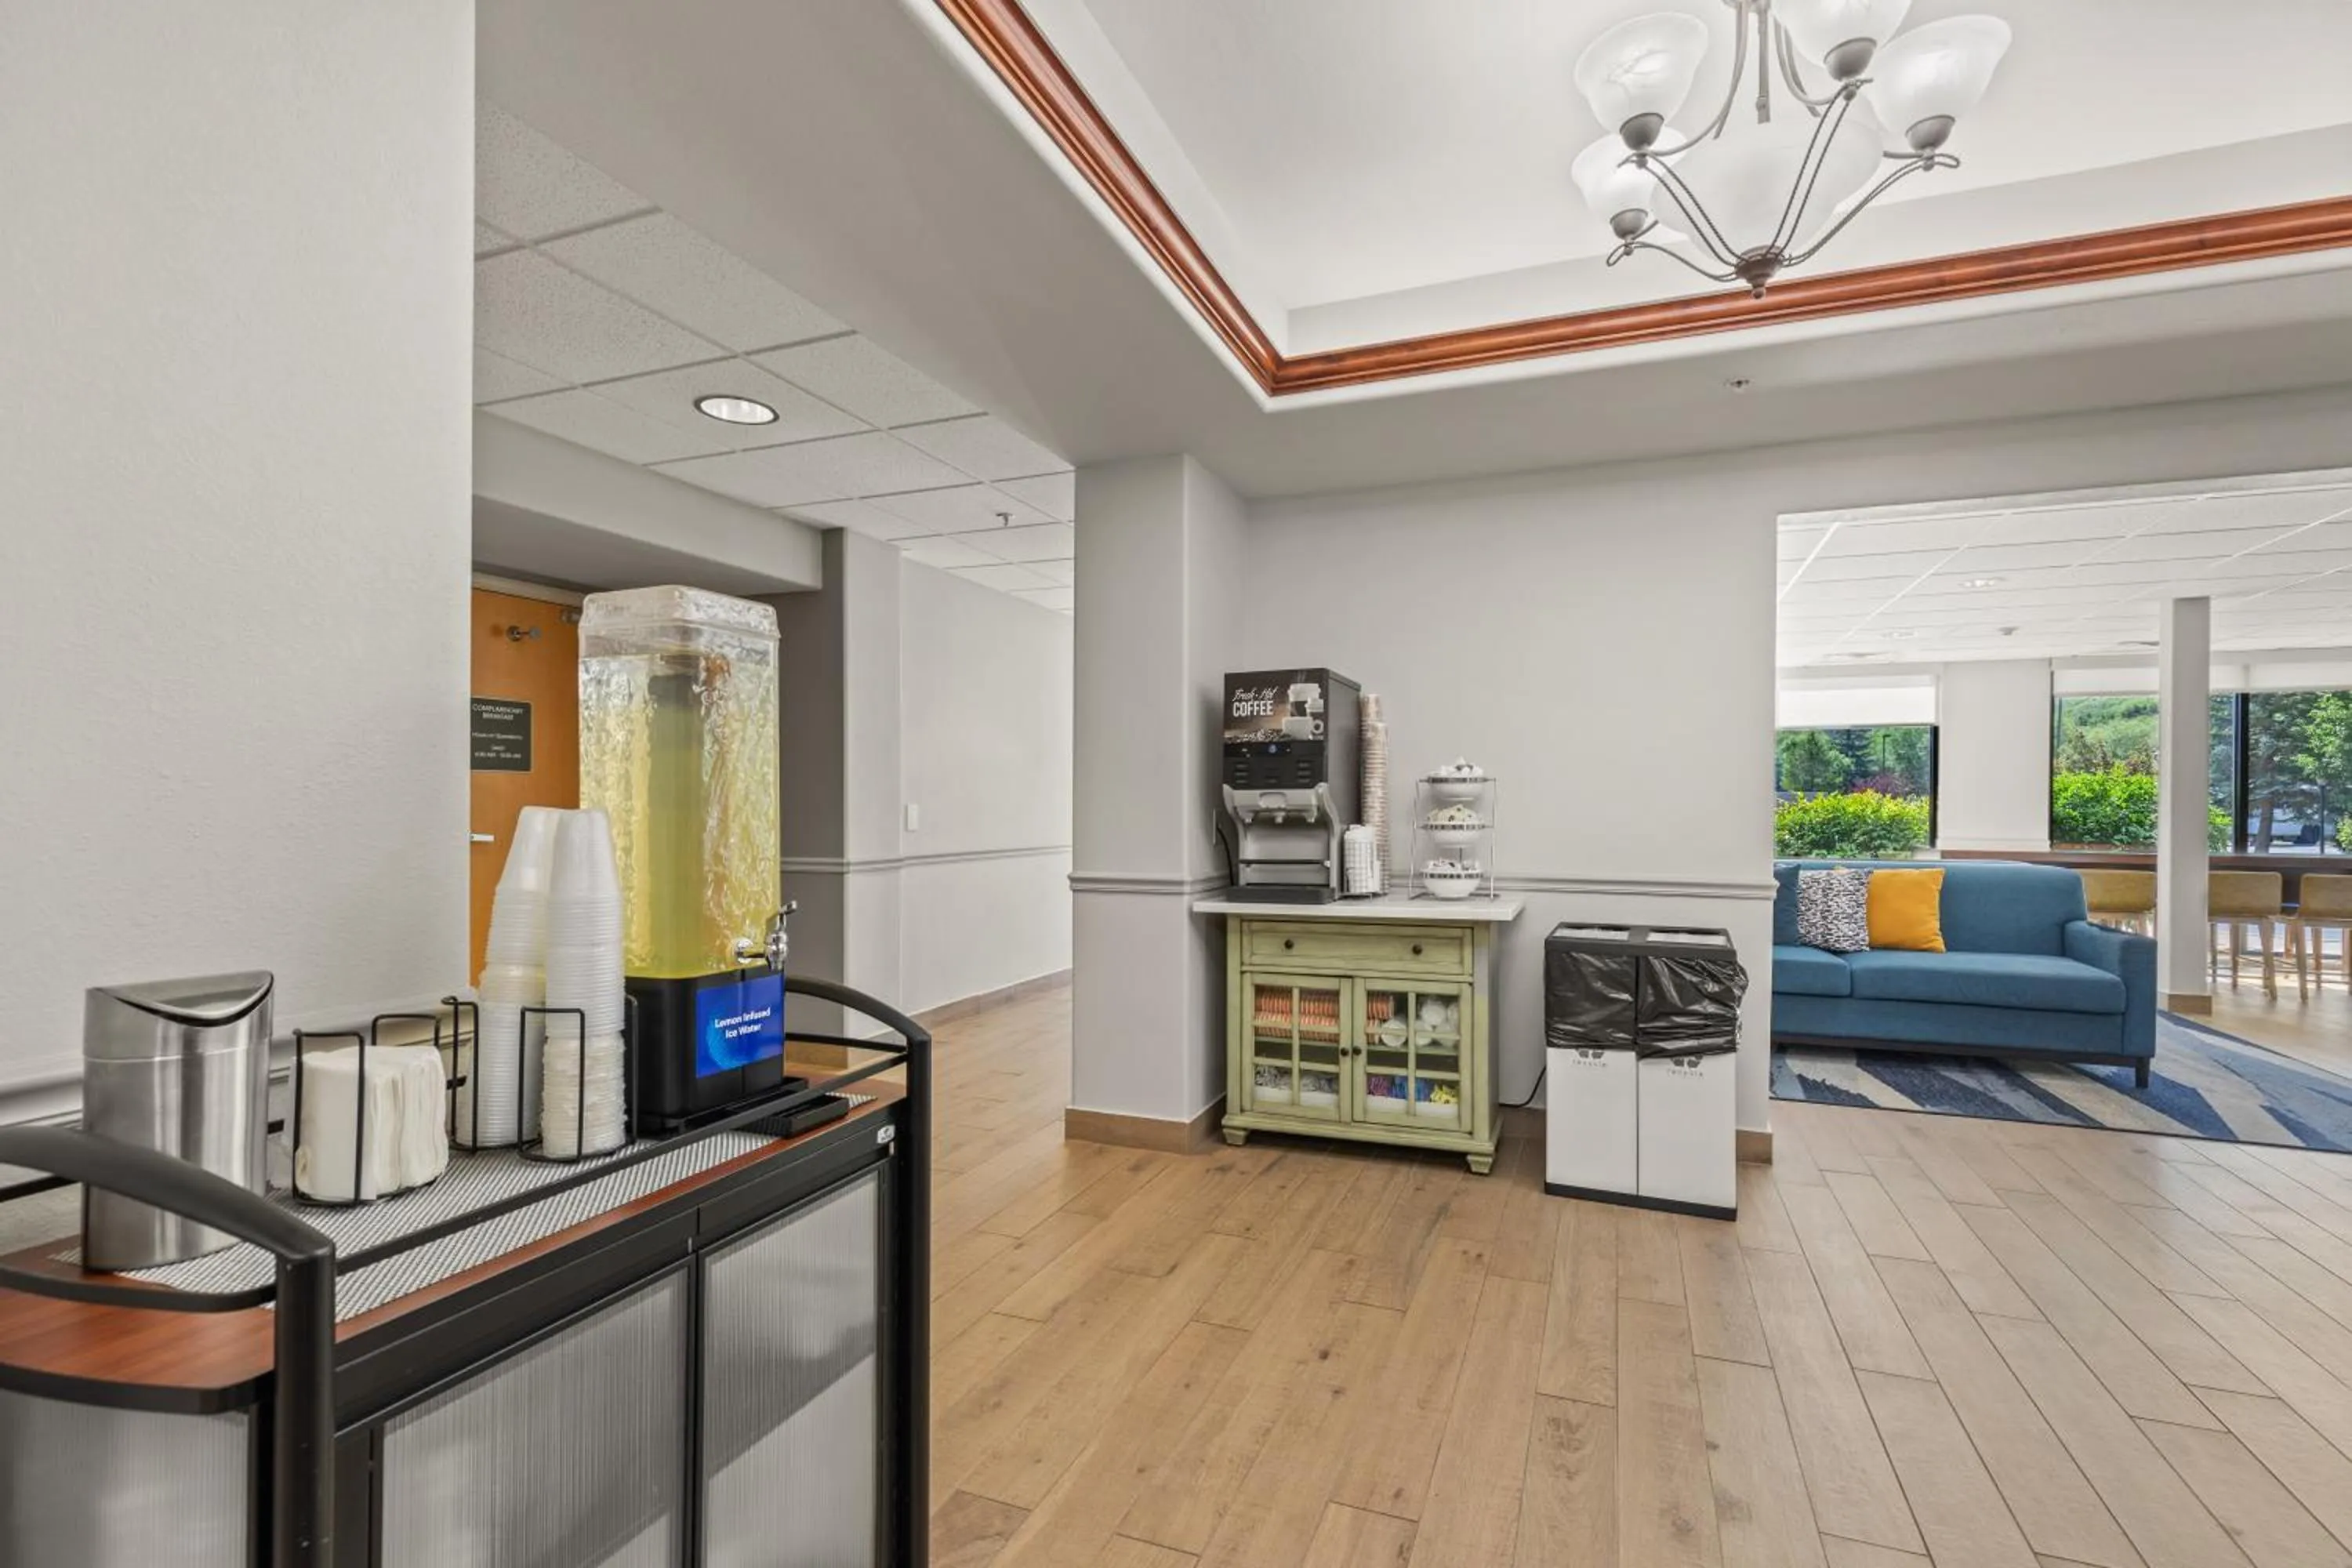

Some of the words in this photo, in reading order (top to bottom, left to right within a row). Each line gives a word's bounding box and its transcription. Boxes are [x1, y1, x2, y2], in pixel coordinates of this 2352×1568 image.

[1232, 688, 1256, 701] Fresh
[1259, 686, 1278, 699] Hot
[1232, 701, 1274, 717] COFFEE
[714, 1014, 742, 1028] Lemon
[743, 1007, 771, 1022] Infused
[725, 1029, 738, 1039] Ice
[739, 1024, 762, 1036] Water
